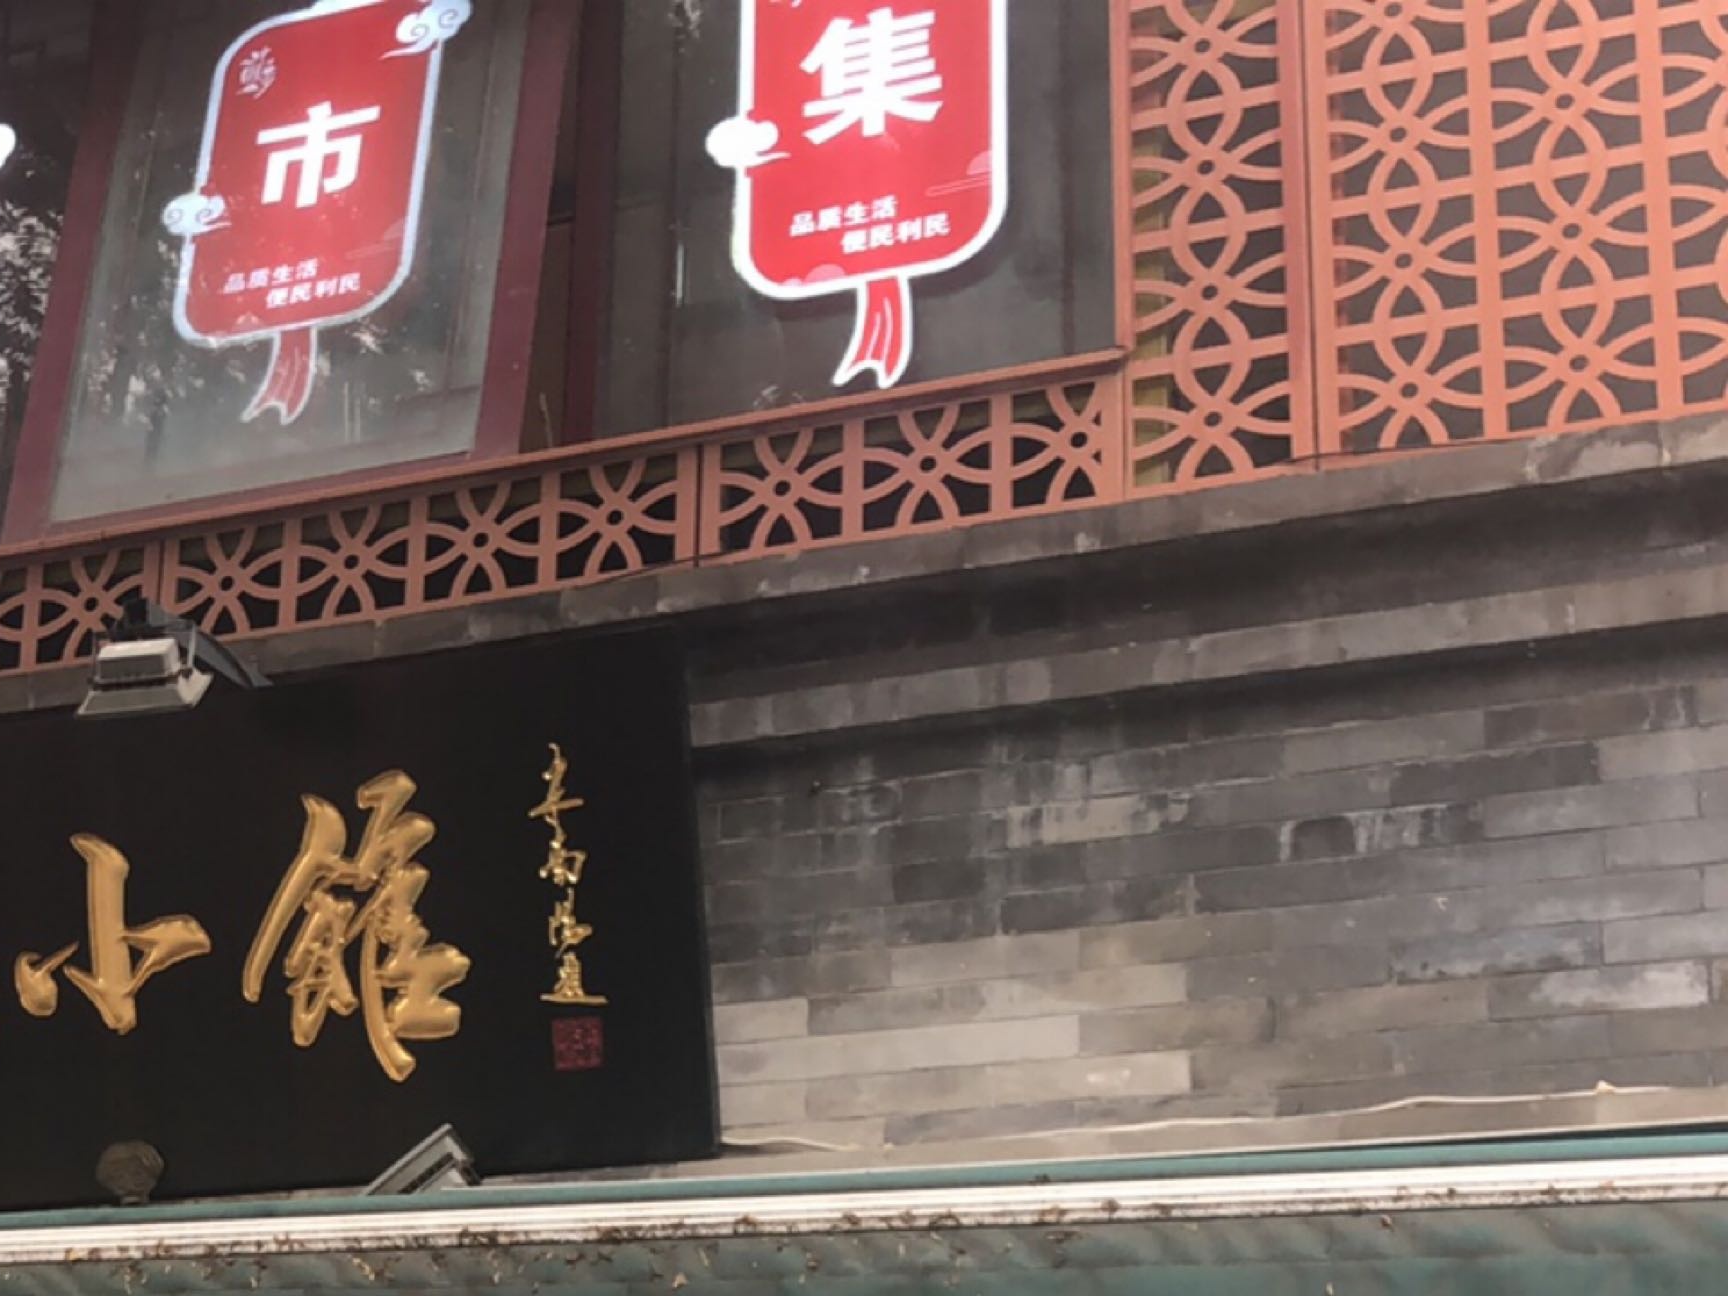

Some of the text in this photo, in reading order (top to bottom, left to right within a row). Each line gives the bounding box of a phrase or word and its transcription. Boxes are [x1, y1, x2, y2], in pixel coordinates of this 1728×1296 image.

[799, 6, 943, 147] 集
[256, 101, 380, 209] 市
[789, 193, 898, 238] 品质生活
[841, 210, 951, 254] 便民利民
[222, 257, 319, 295] 品质生活
[265, 271, 362, 309] 便民利民
